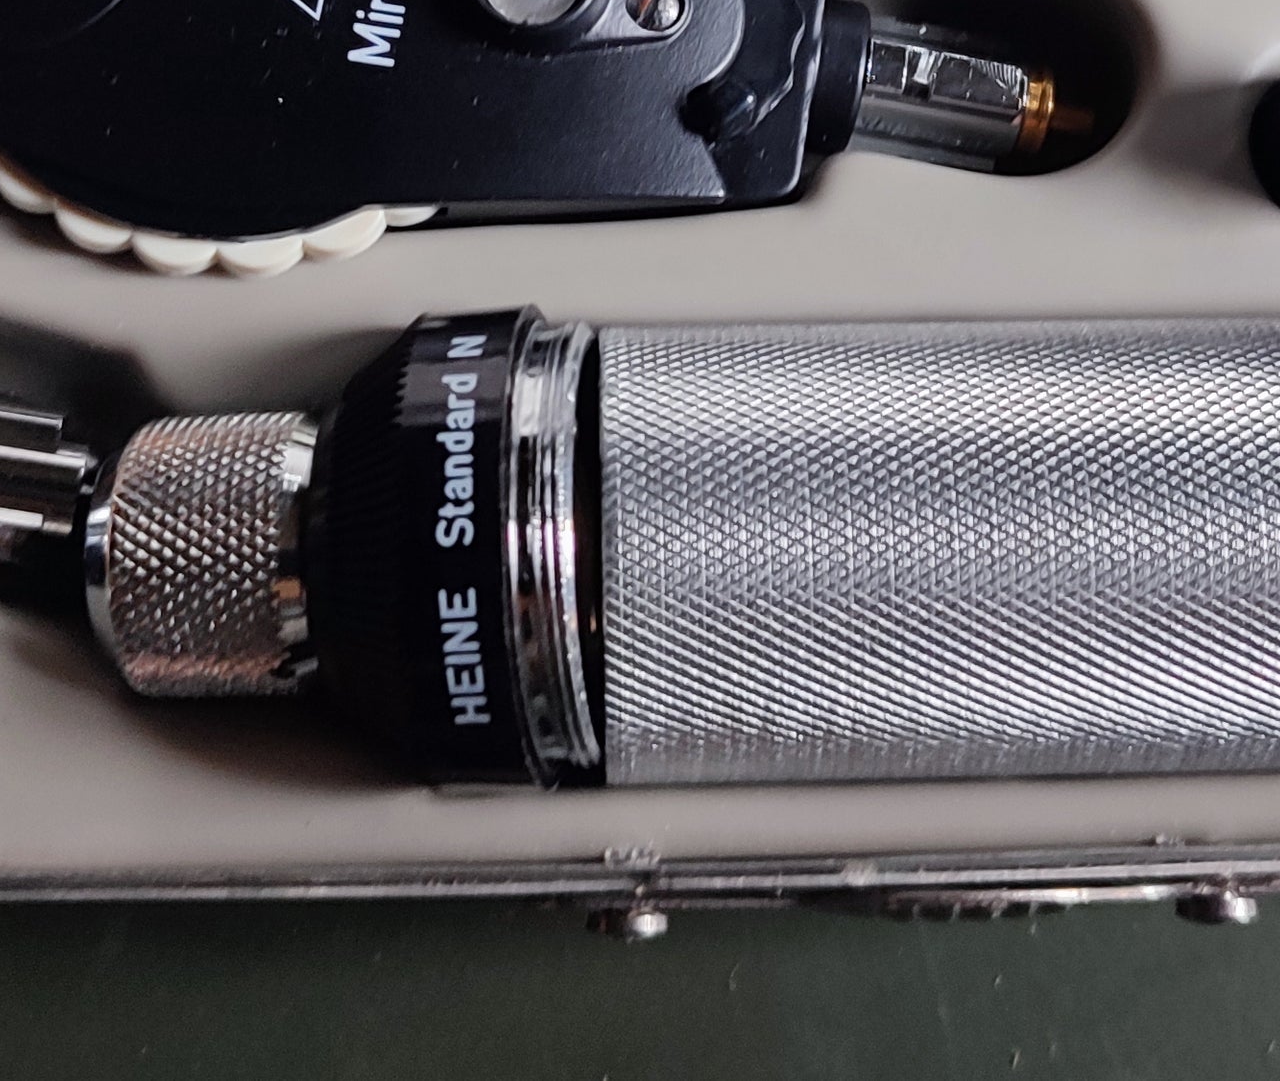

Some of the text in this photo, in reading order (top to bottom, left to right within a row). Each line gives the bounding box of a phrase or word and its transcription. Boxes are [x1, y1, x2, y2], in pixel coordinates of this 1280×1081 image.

[435, 334, 491, 725] HEINE Standard N
